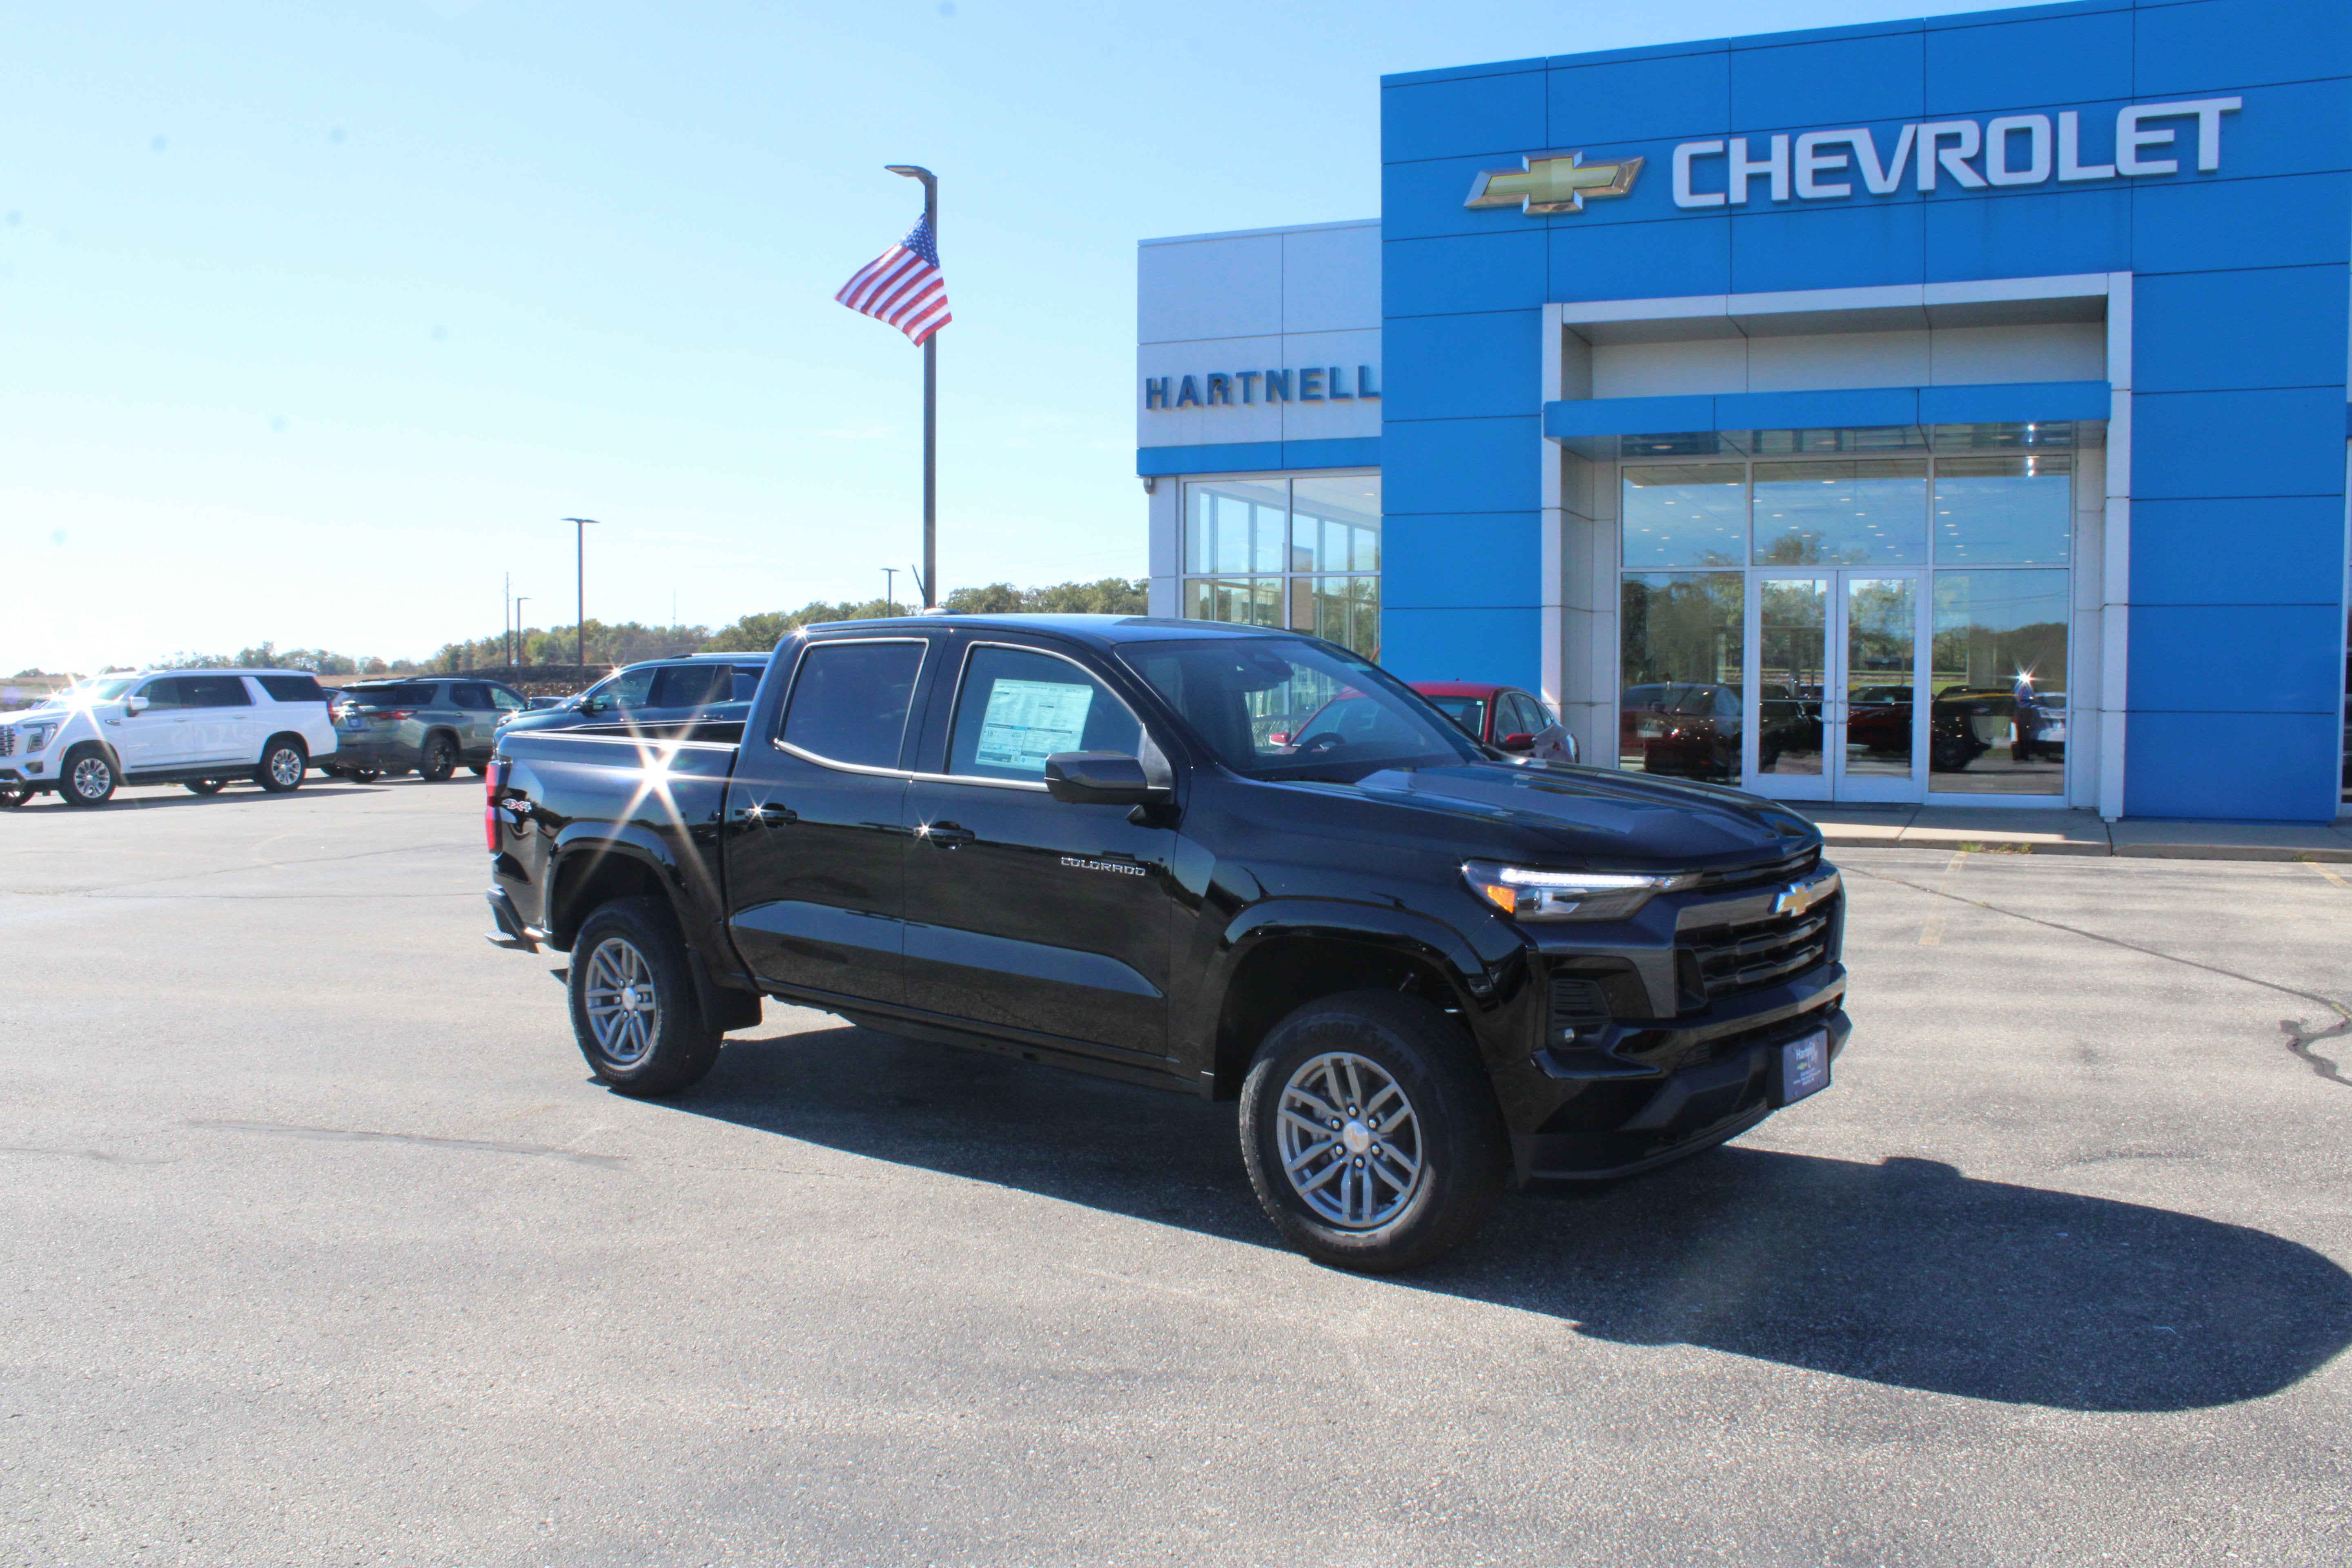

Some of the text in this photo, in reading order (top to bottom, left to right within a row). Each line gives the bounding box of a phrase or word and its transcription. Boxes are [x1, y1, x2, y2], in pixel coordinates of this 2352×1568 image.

[1672, 96, 2242, 209] CHEVROLET
[1146, 365, 1381, 410] HARTNELL
[1061, 857, 1145, 876] COLORADO
